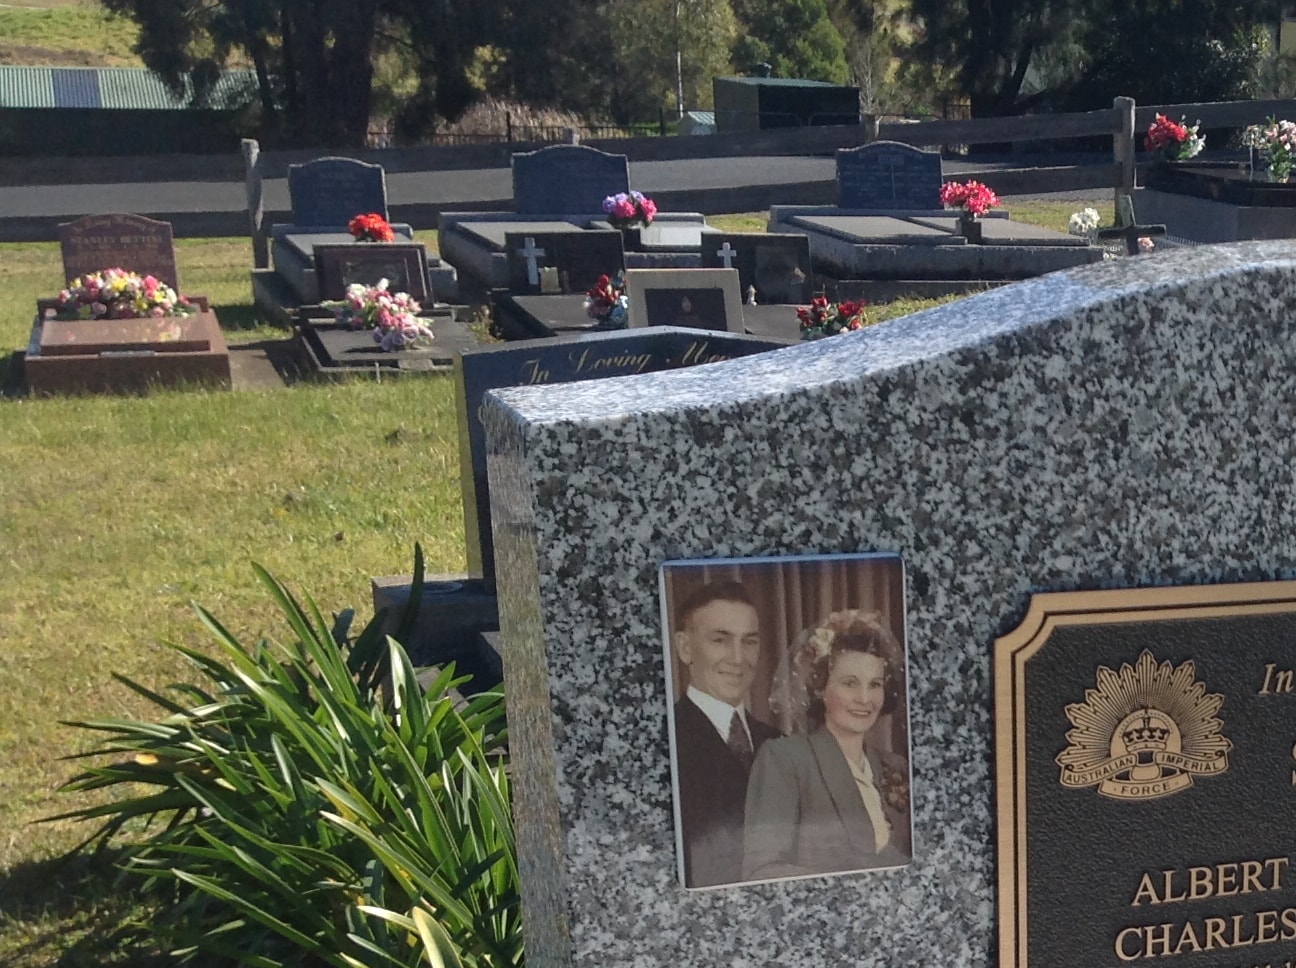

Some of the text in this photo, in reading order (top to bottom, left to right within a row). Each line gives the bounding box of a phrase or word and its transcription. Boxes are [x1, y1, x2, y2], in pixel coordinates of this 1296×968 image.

[518, 358, 551, 385] In
[568, 347, 652, 376] Loving
[1259, 662, 1294, 696] In
[1065, 754, 1219, 783] AUSTRALIAN IMPERIAL
[1120, 782, 1171, 794] FORCE
[1131, 857, 1289, 908] ALBERT
